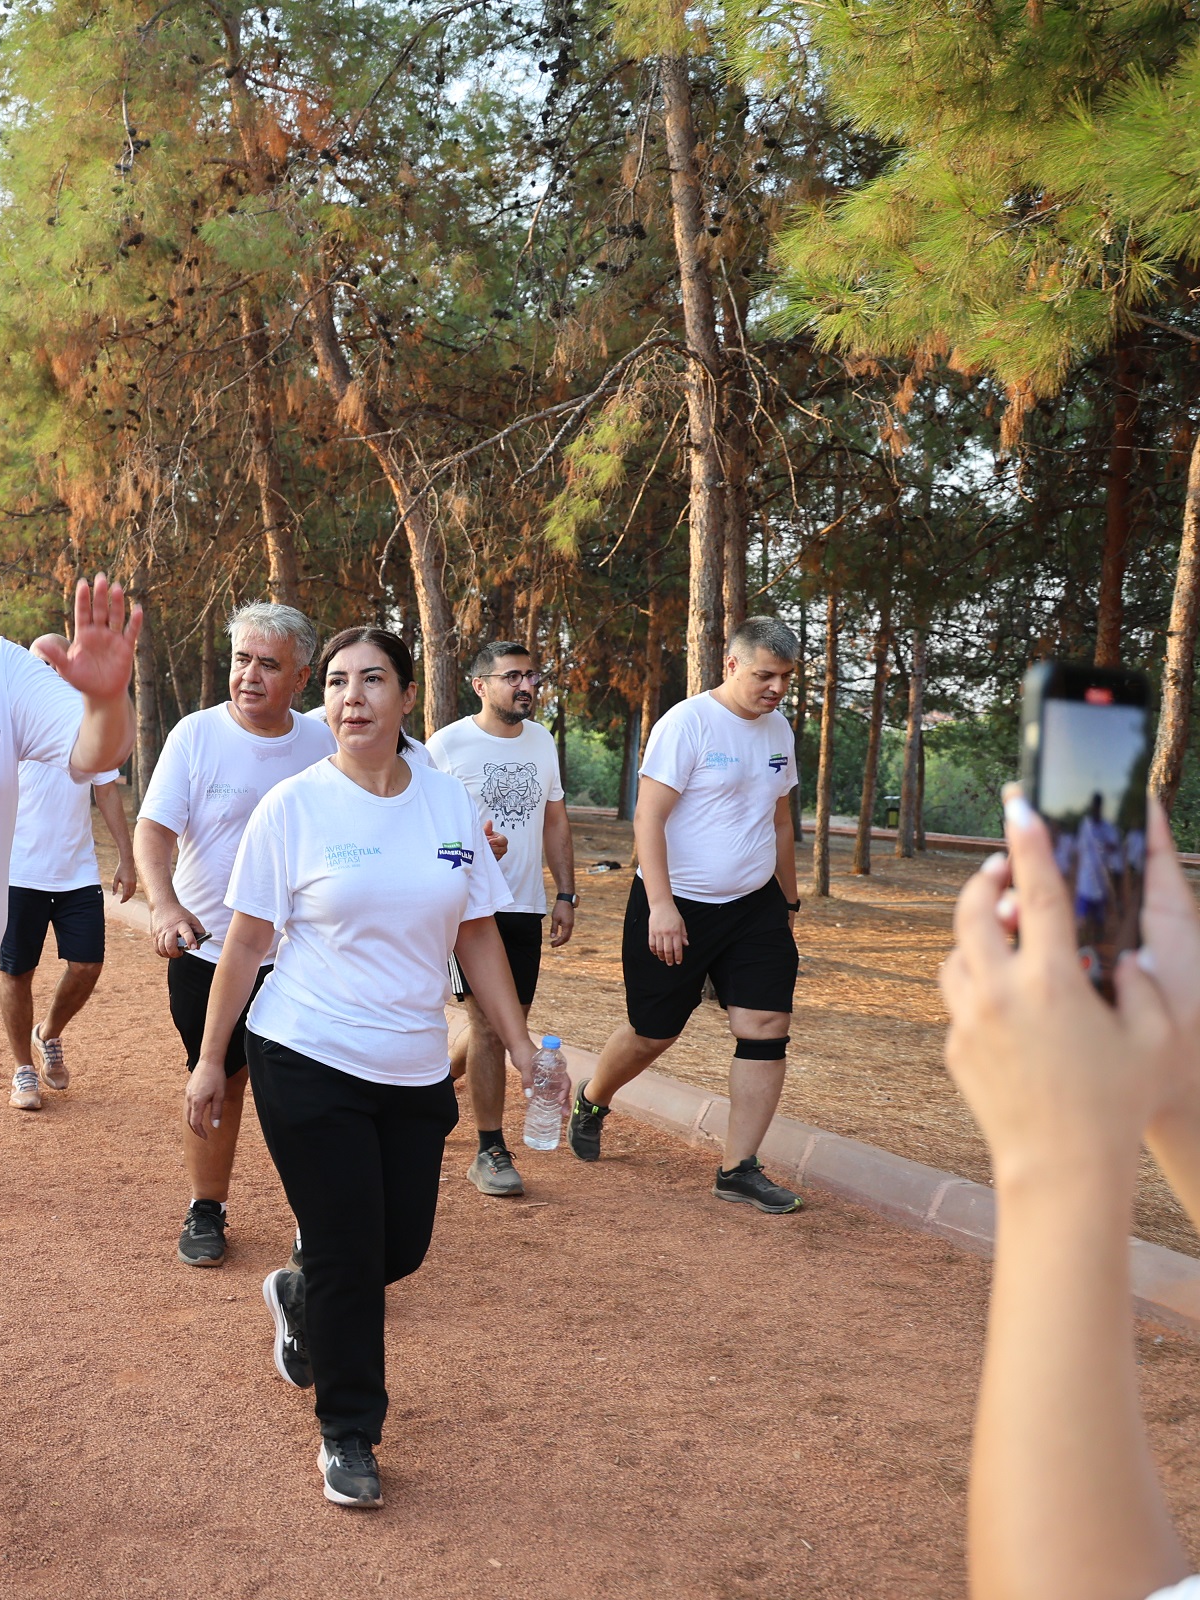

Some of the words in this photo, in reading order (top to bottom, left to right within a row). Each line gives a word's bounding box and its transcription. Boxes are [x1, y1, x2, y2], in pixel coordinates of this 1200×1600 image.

[494, 813, 531, 830] PARIS
[324, 845, 382, 861] HAREKETLİLİK
[325, 842, 358, 853] AVRUPA
[326, 855, 360, 868] HAFTASI
